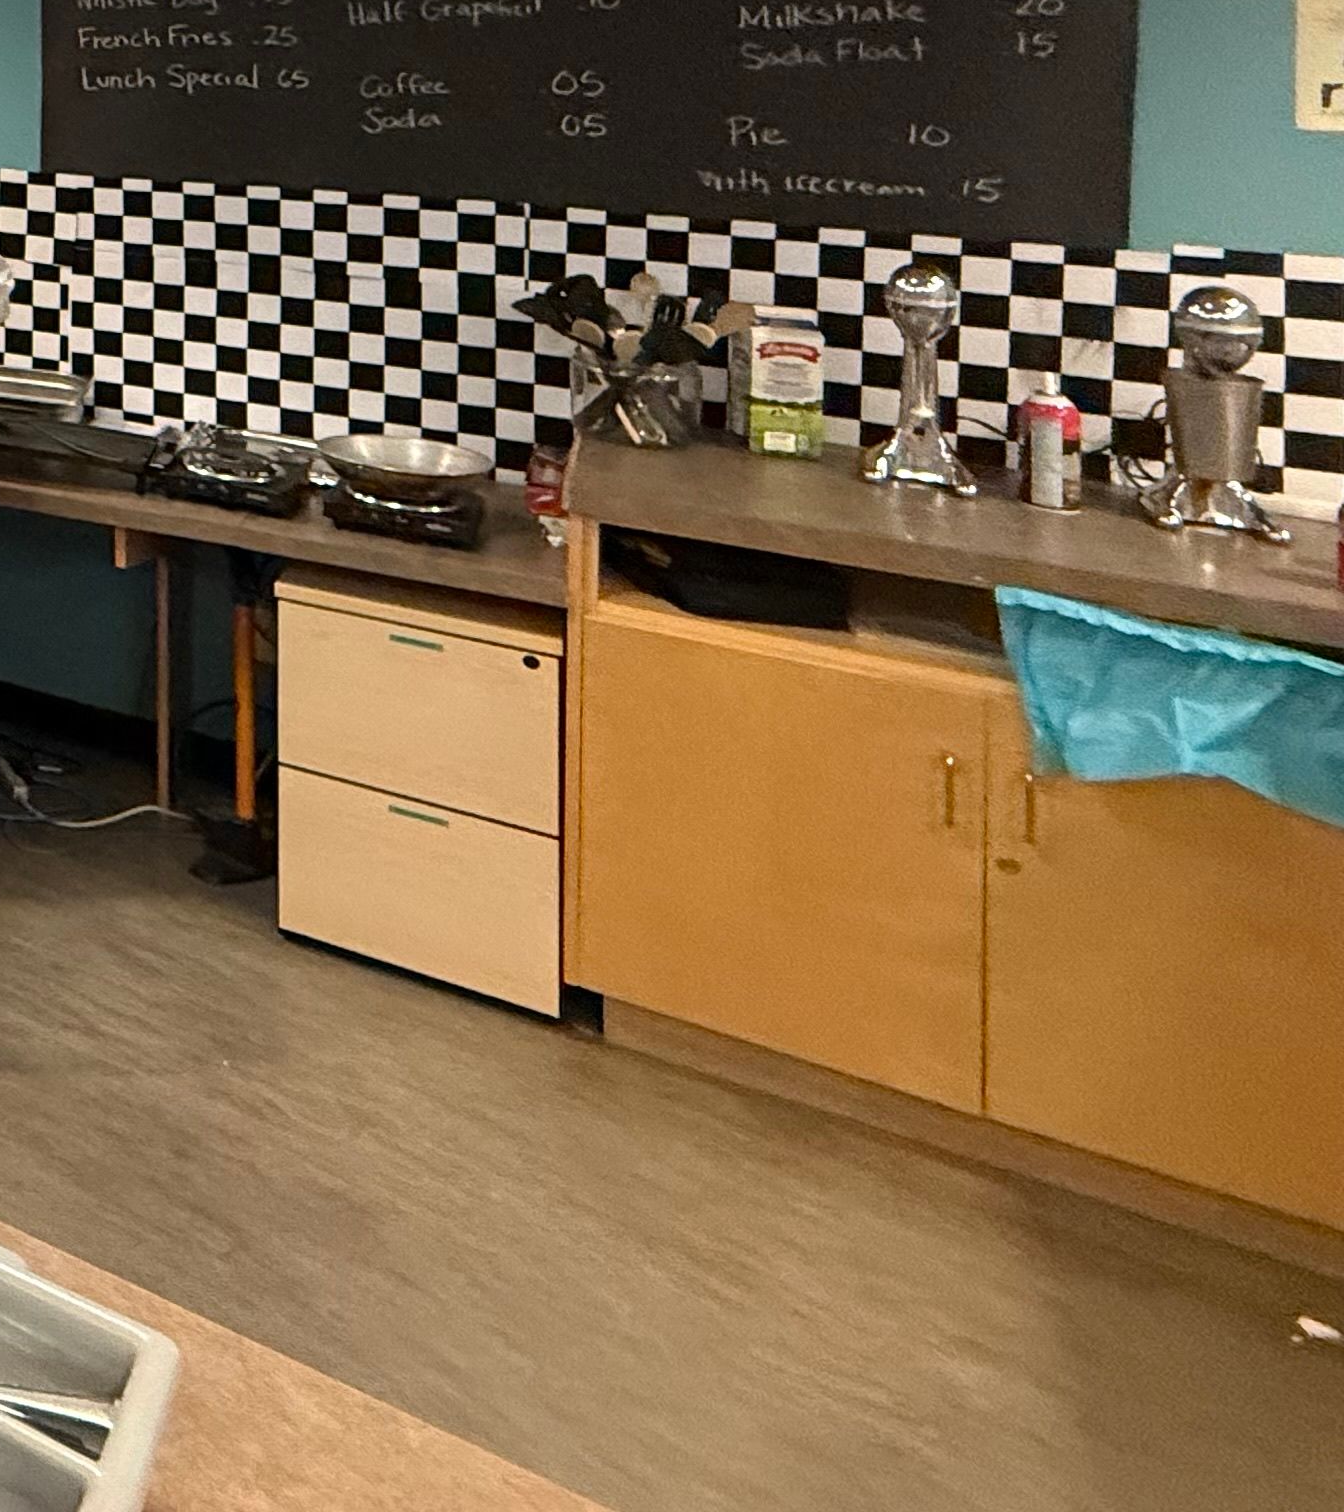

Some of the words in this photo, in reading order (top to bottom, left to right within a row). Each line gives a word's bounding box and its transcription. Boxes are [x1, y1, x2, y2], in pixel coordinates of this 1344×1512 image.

[347, 0, 409, 27] Half
[77, 26, 162, 49] French
[167, 23, 233, 48] Fries
[739, 41, 827, 71] Soda
[837, 35, 925, 63] Float
[80, 67, 157, 91] Lunch
[165, 63, 261, 96] Special
[358, 70, 451, 99] Coffee
[360, 106, 443, 135] Soda
[726, 114, 790, 147] Pie
